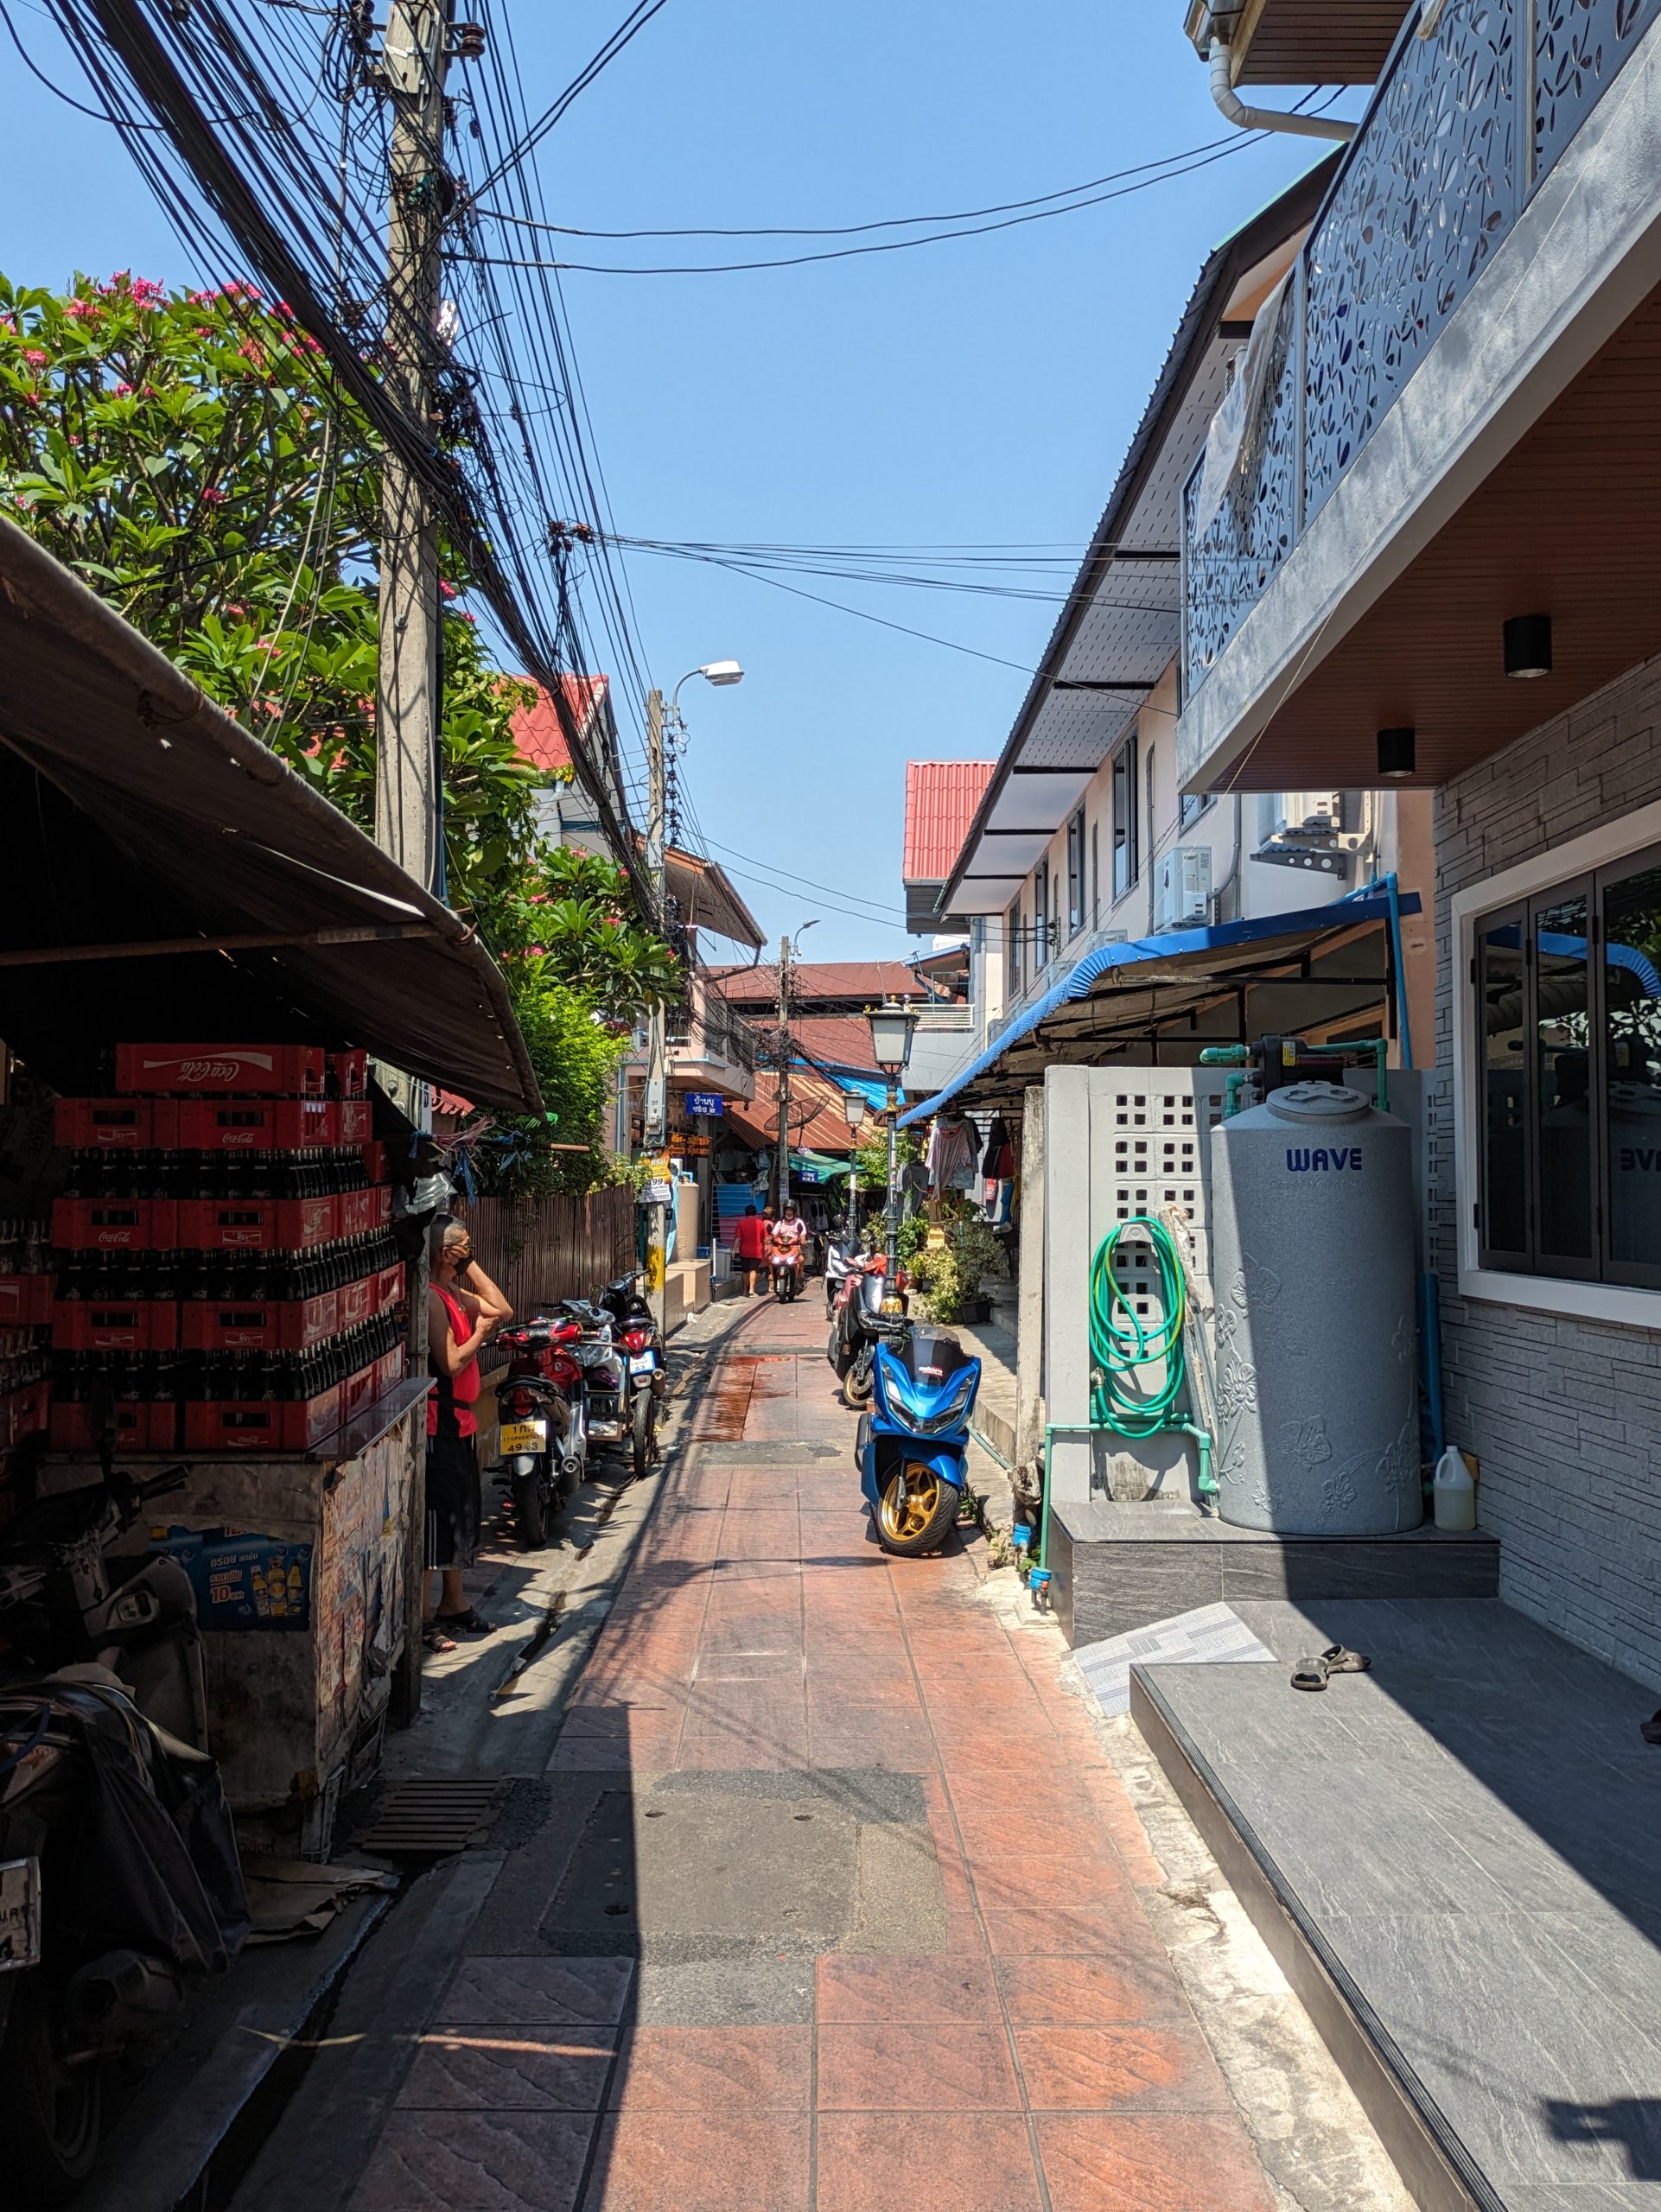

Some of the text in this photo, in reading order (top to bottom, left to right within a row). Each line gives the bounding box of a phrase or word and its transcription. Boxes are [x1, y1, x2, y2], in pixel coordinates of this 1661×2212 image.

[178, 1060, 240, 1083] Coca-Cola
[694, 1095, 715, 1108] บ้านบุ
[221, 1132, 254, 1144] Coca-Cola
[1286, 1147, 1363, 1172] WAVE
[99, 1230, 130, 1243] Coca-Cola
[210, 1585, 232, 1605] 10
